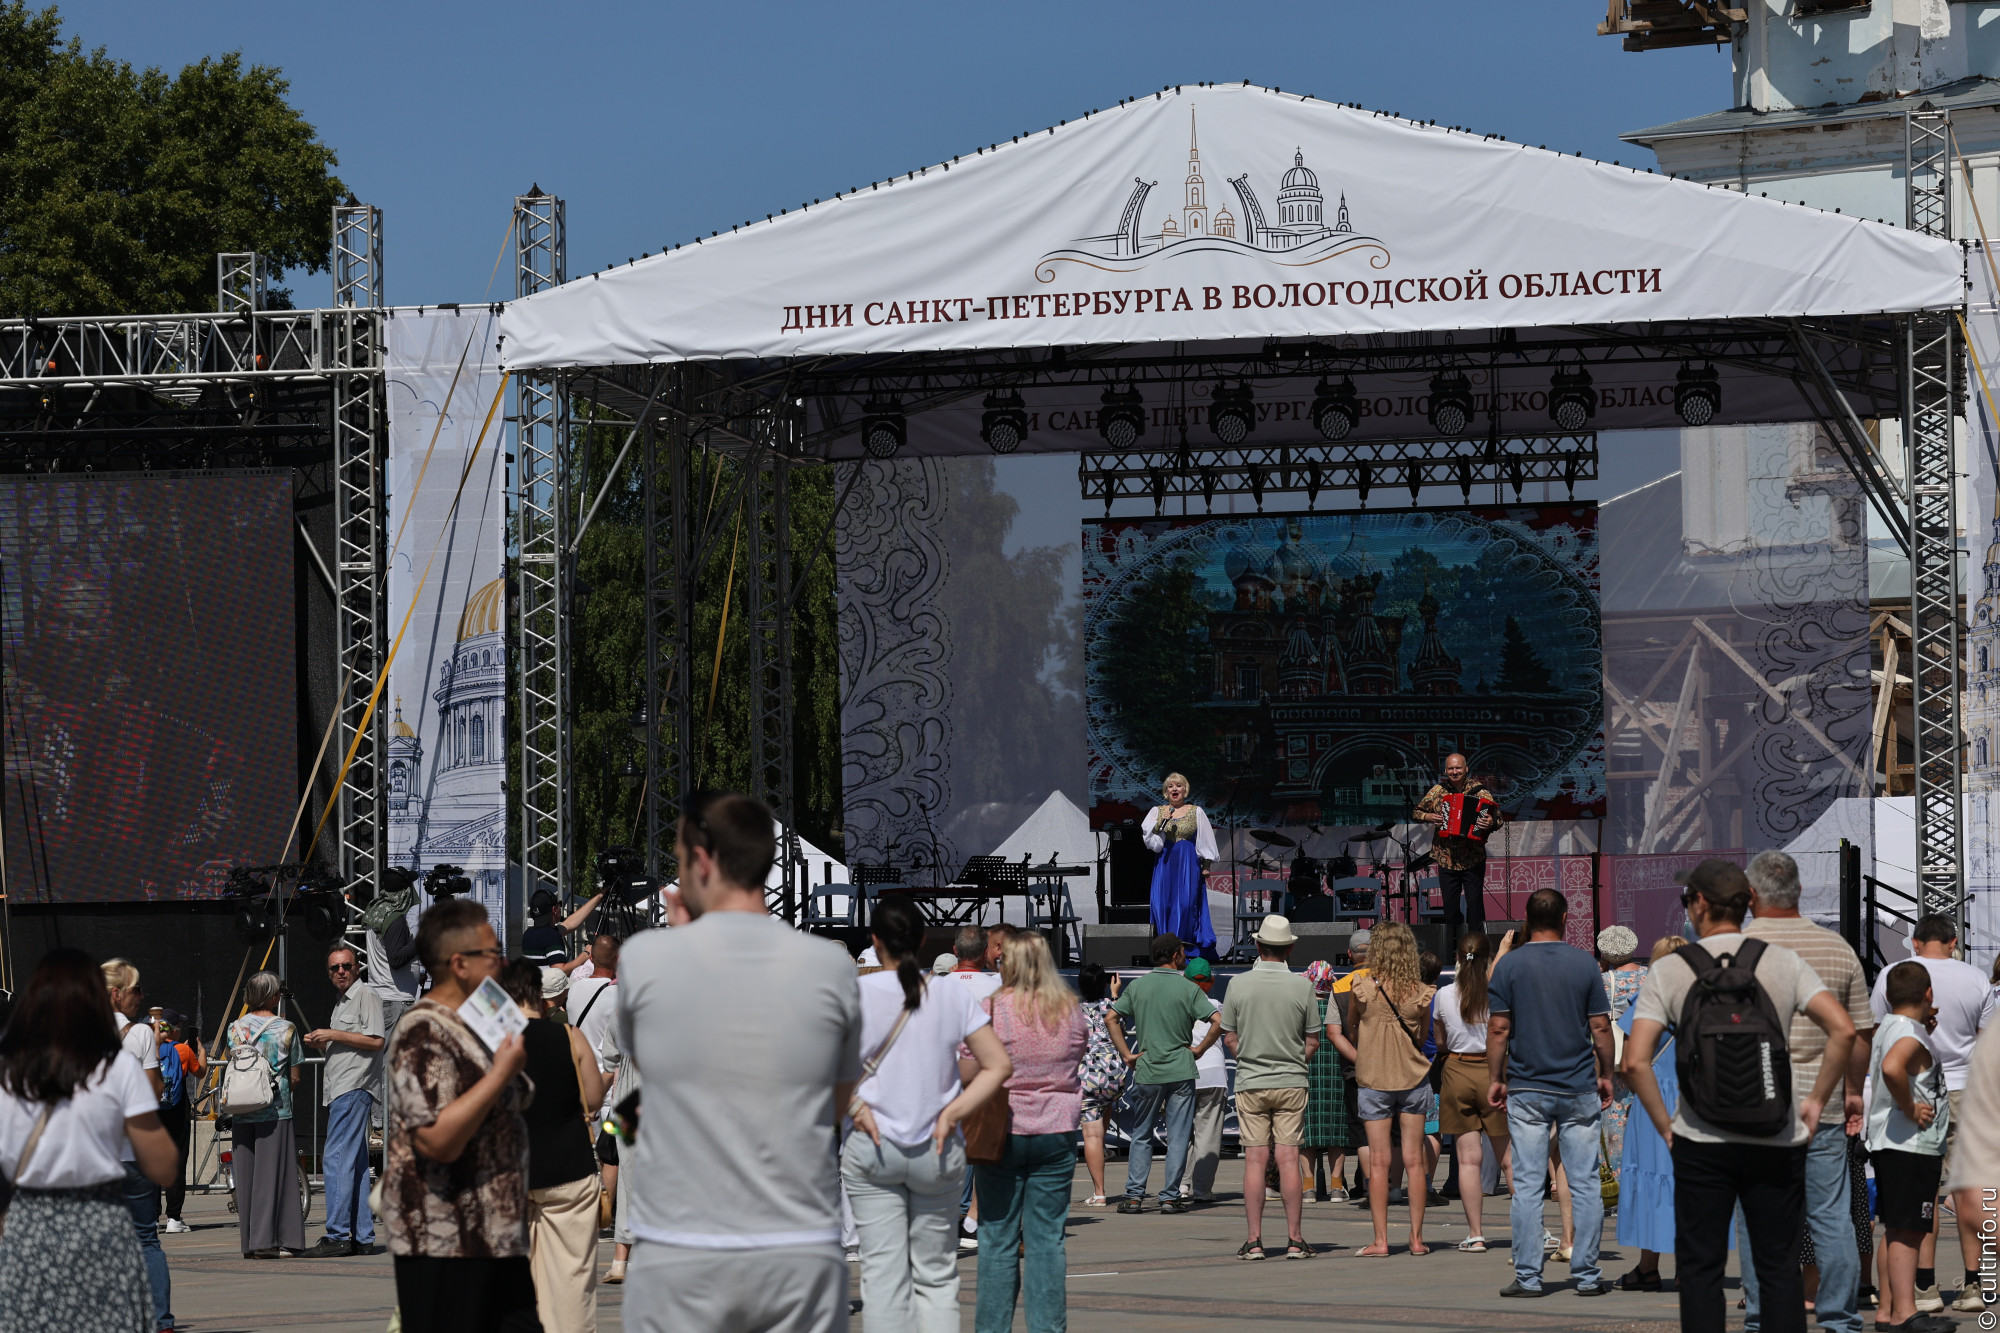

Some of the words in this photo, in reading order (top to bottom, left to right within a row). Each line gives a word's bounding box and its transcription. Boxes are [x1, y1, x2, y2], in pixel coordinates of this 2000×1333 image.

[781, 303, 854, 334] ДНИ
[864, 286, 1194, 327] САНКТ-ПЕТЕРБУРГА
[1203, 286, 1222, 310] В
[1232, 269, 1489, 310] ВОЛОГОДСКОЙ
[1498, 268, 1662, 299] ОБЛАСТИ
[1760, 1041, 1776, 1100] SWISSGEAR
